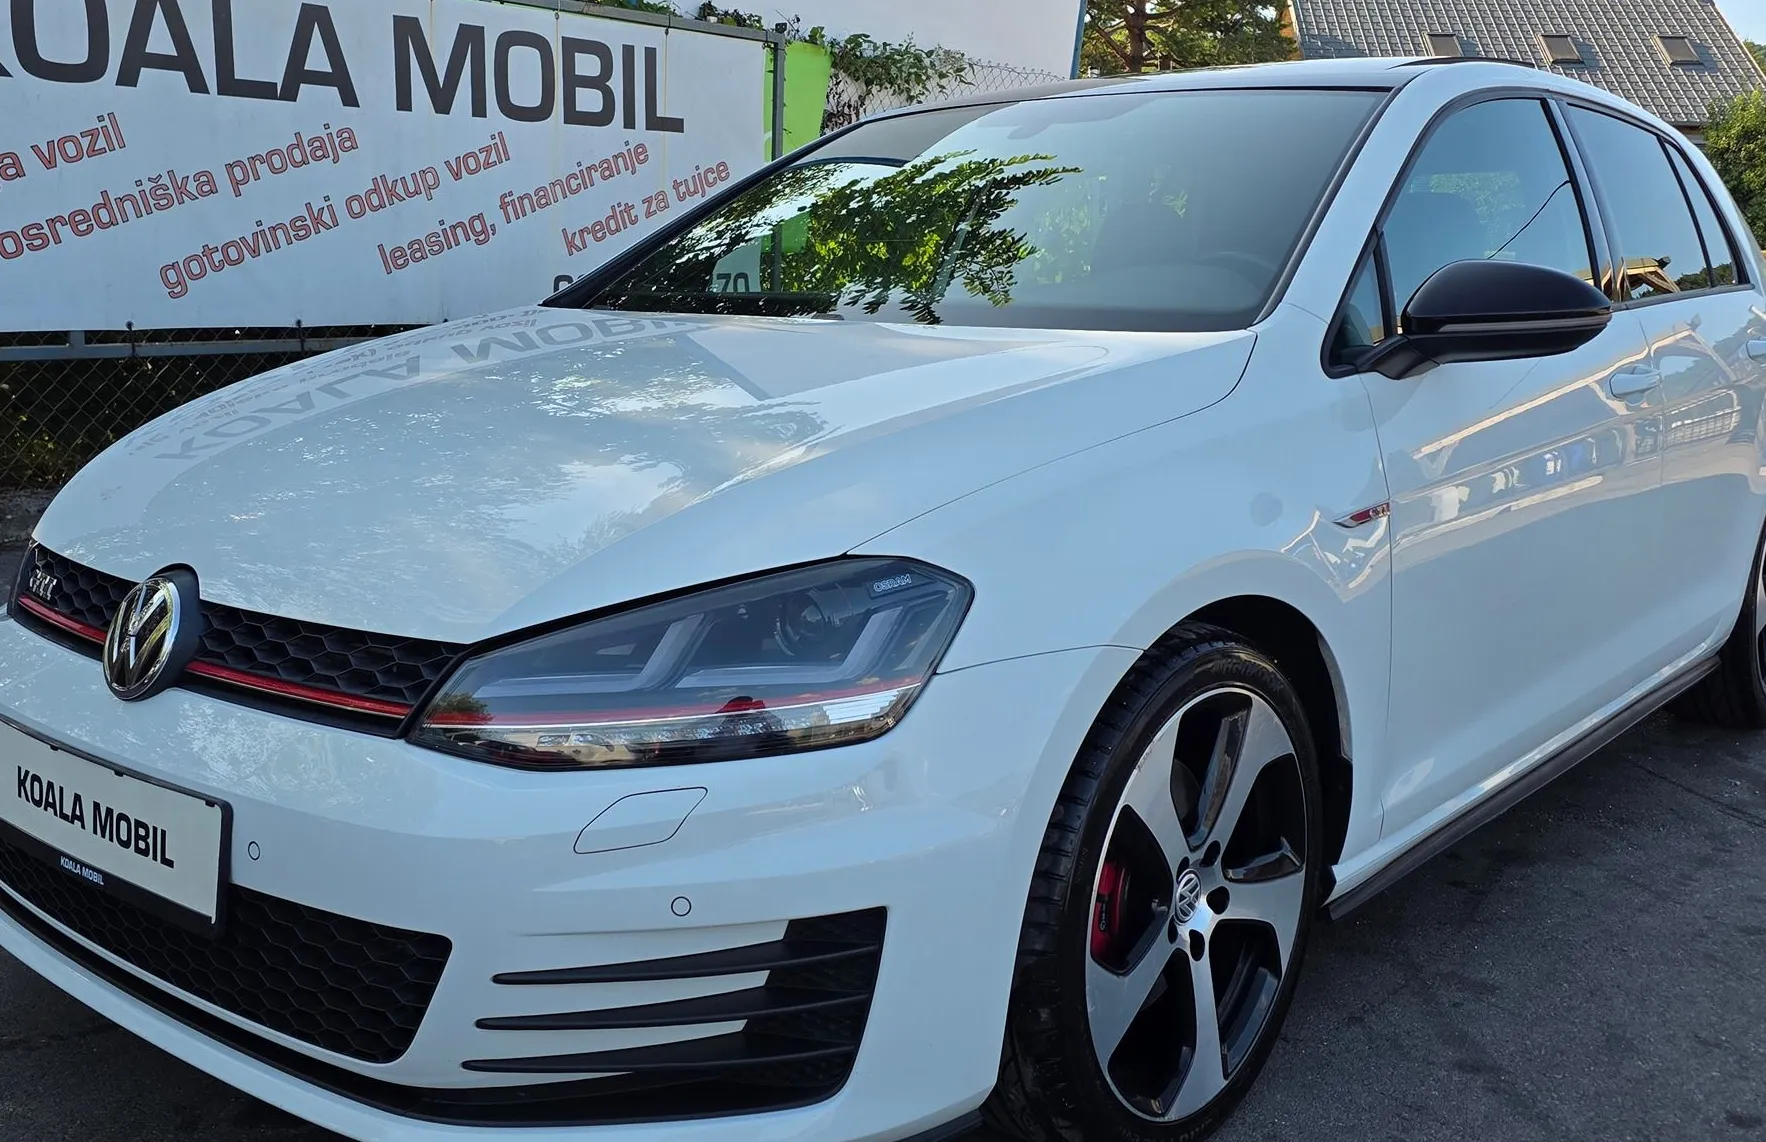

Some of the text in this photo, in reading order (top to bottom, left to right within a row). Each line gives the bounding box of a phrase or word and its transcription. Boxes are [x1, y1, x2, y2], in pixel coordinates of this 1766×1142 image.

[0, 0, 684, 133] OALA MOBIL
[30, 112, 126, 170] vozil
[224, 123, 359, 197] prodaja
[159, 131, 511, 299] gotovinski odkup vozil
[377, 140, 649, 275] leasing, financiranje
[561, 161, 731, 257] kredit za tujce
[873, 573, 912, 593] OSRAM
[17, 764, 175, 869] KOALA MOBIL
[60, 855, 105, 886] KOALA MOBIL
